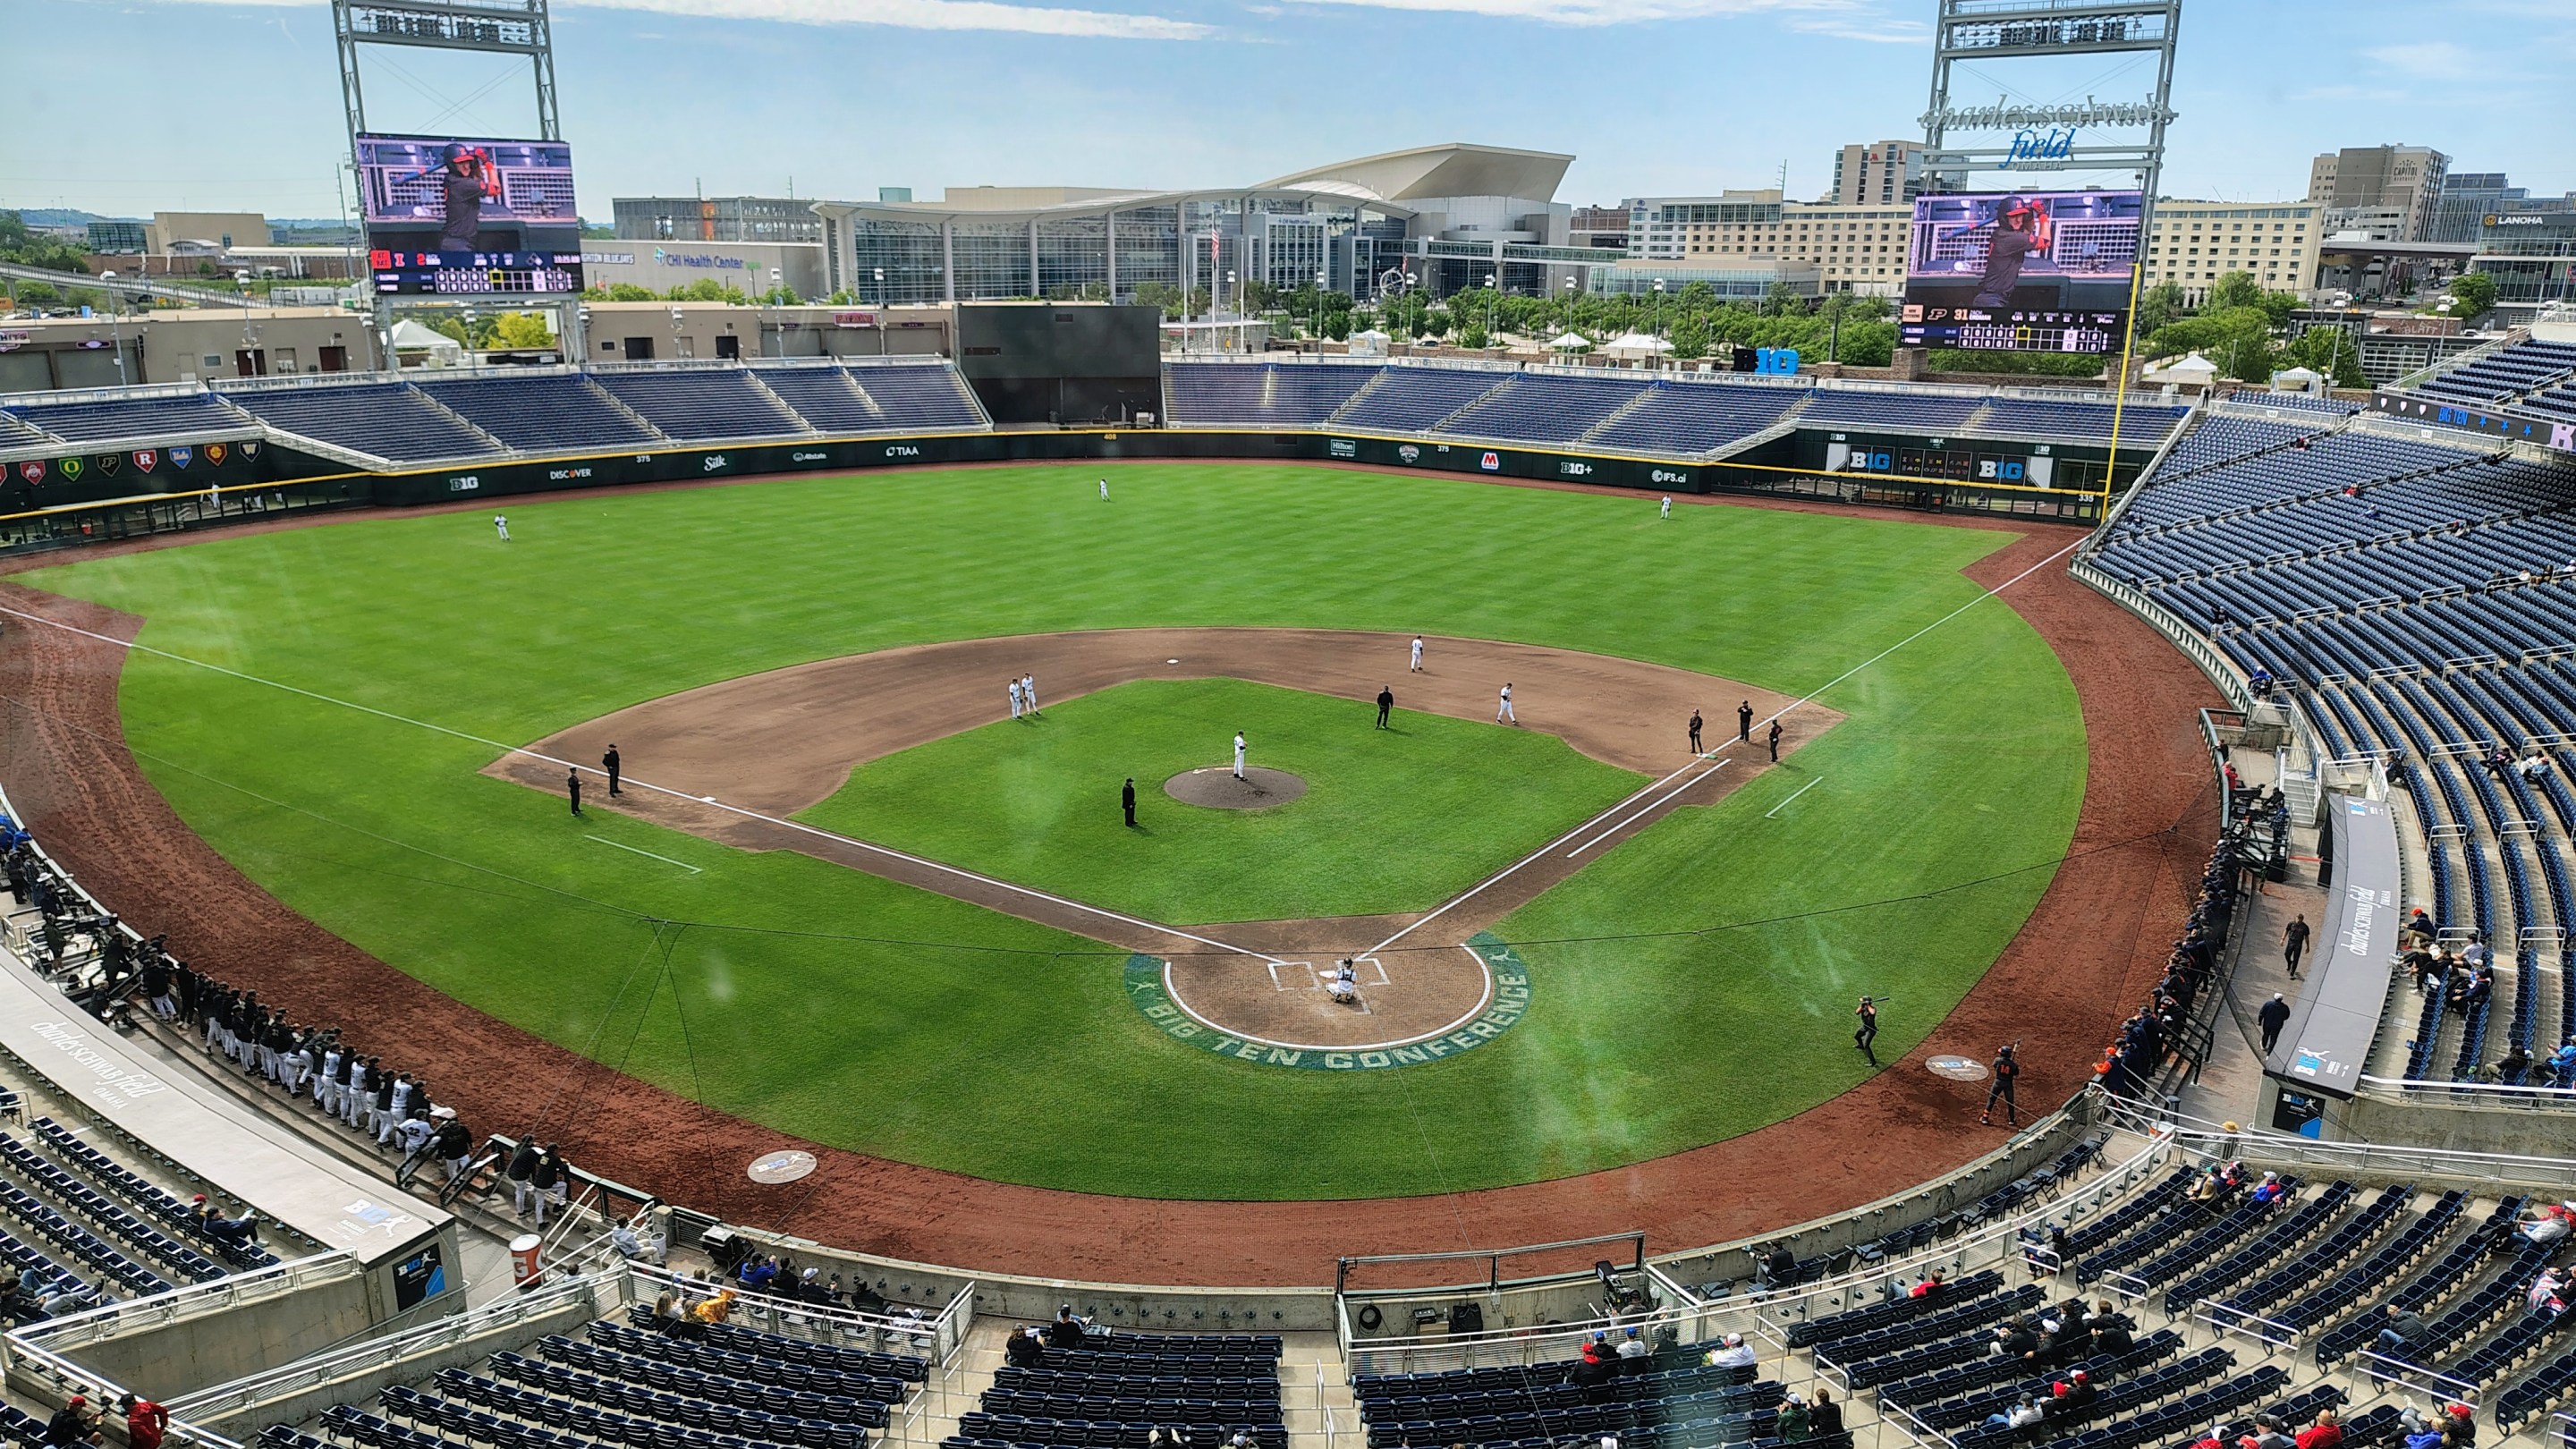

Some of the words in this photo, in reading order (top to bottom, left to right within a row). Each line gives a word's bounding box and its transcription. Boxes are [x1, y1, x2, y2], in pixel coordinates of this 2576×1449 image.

[1998, 128, 2076, 168] field
[2394, 166, 2417, 176] CAPITOL
[2498, 216, 2543, 225] LANOHA
[666, 255, 681, 266] CHI
[683, 255, 713, 267] Health
[715, 257, 743, 268] Center
[1928, 309, 1947, 320] P
[1953, 309, 1968, 321] 31
[2404, 326, 2438, 335] BLATT
[2437, 407, 2452, 423] BIG
[2453, 410, 2469, 426] TEN
[242, 444, 257, 454] W
[895, 446, 919, 456] TIAA
[1333, 442, 1352, 450] Hilton
[101, 457, 116, 468] P
[140, 453, 152, 464] R
[636, 455, 651, 463] 375
[704, 454, 726, 471] Silk
[1485, 454, 1496, 464] M
[64, 461, 80, 472] O
[549, 469, 591, 479] DISCOVER
[1663, 471, 1686, 483] IFS.ai
[2078, 494, 2094, 503] 335
[1144, 1004, 1195, 1038] BIG
[1211, 1037, 1301, 1067] TEN
[1324, 973, 1528, 1070] CONFERENCE
[2000, 1064, 2010, 1074] 14
[96, 1073, 166, 1098] field
[93, 1088, 128, 1110] OMAHA
[408, 1126, 420, 1138] 22
